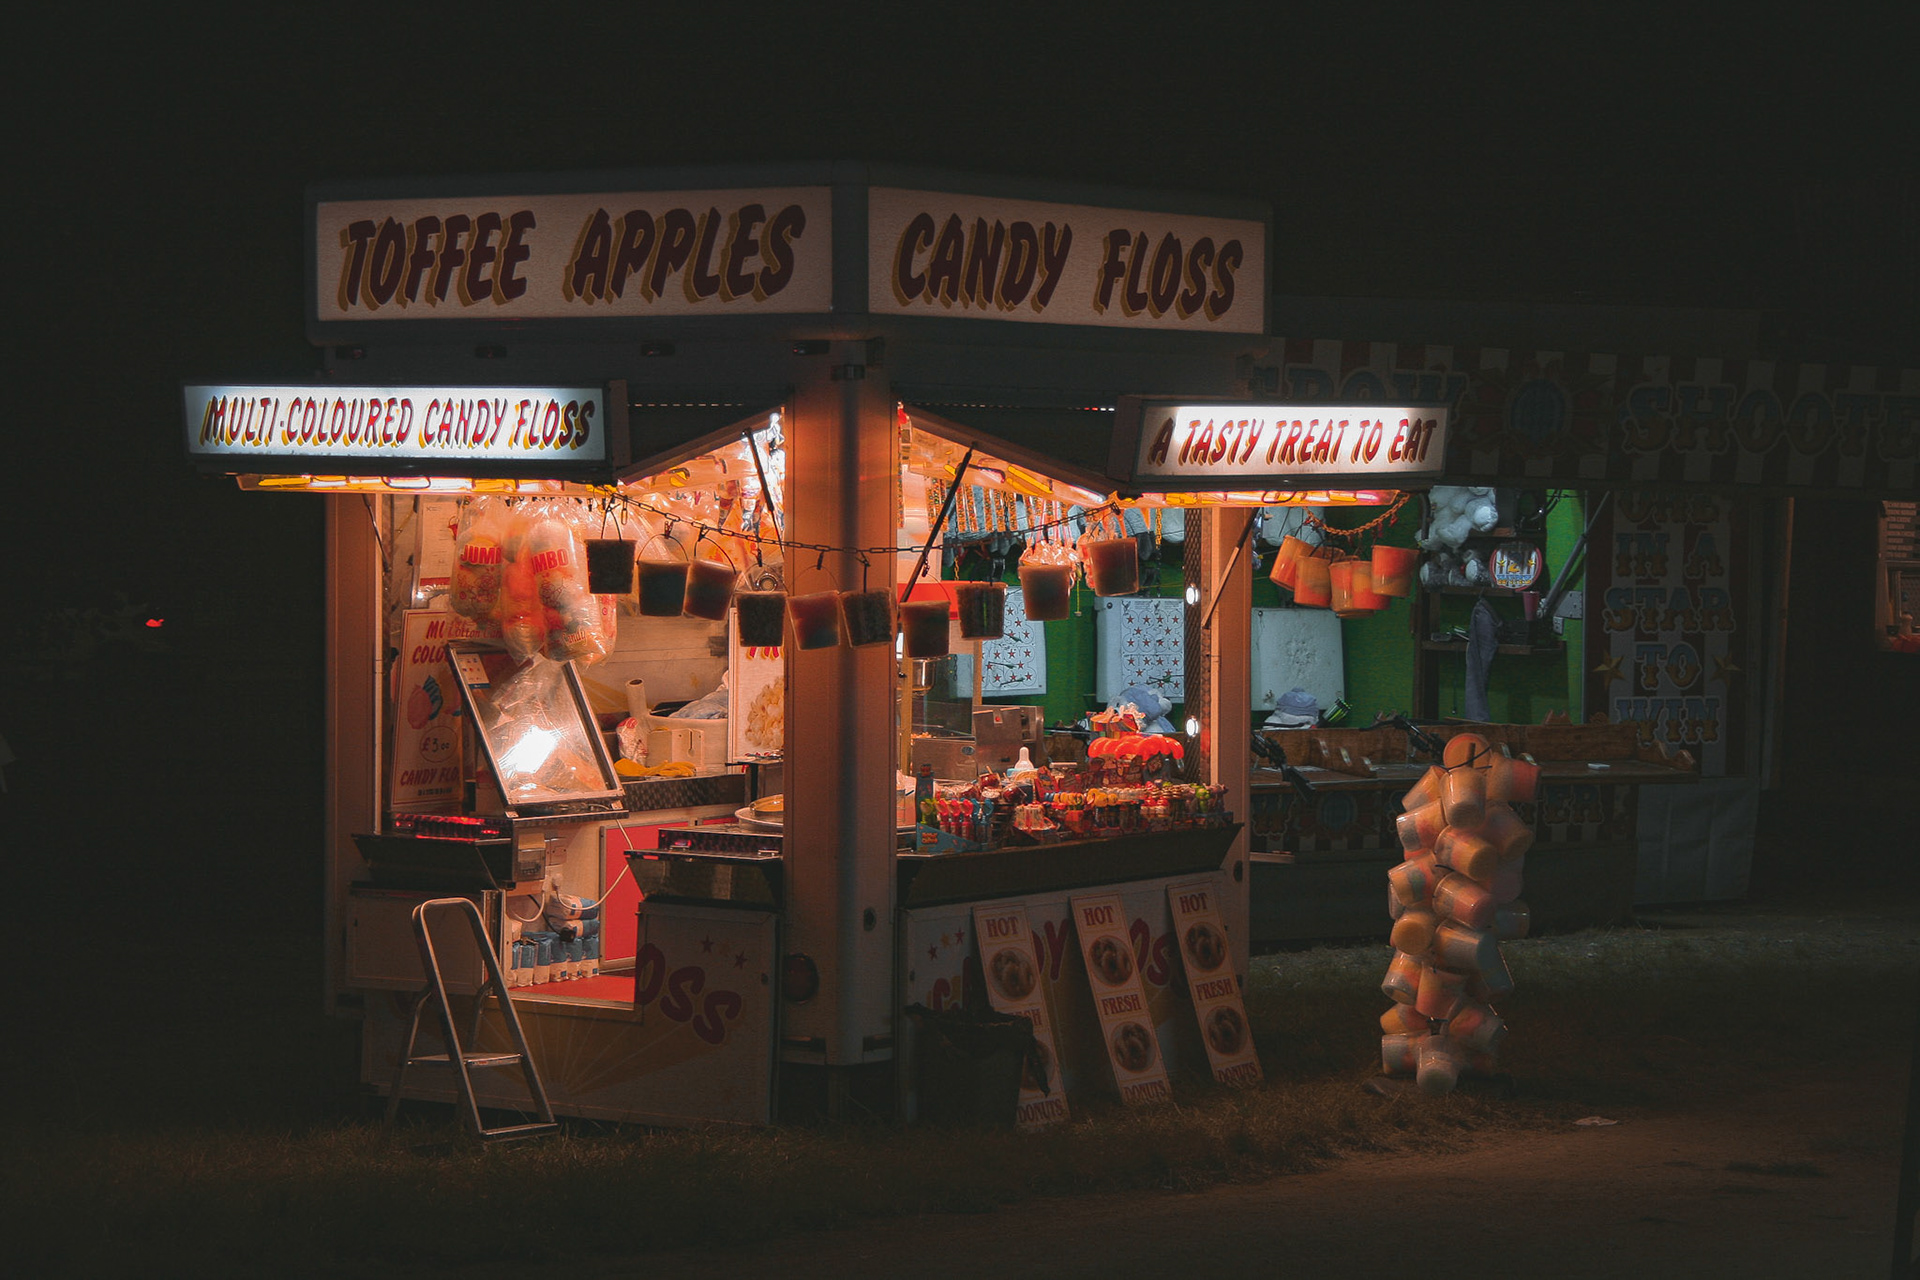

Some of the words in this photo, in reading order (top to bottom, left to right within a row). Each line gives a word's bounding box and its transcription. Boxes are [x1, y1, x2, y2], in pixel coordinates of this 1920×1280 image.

[338, 210, 537, 311] TOFFEE
[563, 204, 806, 305] APPLES
[892, 212, 1073, 314] CANDY
[1093, 228, 1244, 322] FLOSS
[200, 395, 413, 448] MULTI-COLOURED
[418, 397, 508, 450] CANDY
[509, 399, 595, 451] FLOSS
[1147, 417, 1176, 467] A
[1178, 418, 1265, 466] TASTY
[1266, 418, 1350, 466] TREAT
[1350, 418, 1384, 465] TO
[1387, 418, 1438, 466] EAT
[1615, 533, 1670, 578] IN
[1685, 532, 1724, 579] A
[1603, 586, 1735, 633] STAR
[1636, 642, 1702, 690] TO
[1615, 696, 1721, 745] WIN
[400, 768, 437, 786] CANDY
[1083, 905, 1114, 926] HOT
[1178, 892, 1208, 914] HOT
[985, 915, 1019, 938] HOT
[1195, 978, 1234, 1001] FRESH
[1101, 994, 1142, 1015] FRESH
[1216, 1062, 1258, 1084] DONUTS
[1124, 1079, 1167, 1102] DONUTS
[1017, 1098, 1063, 1124] DONUTS
